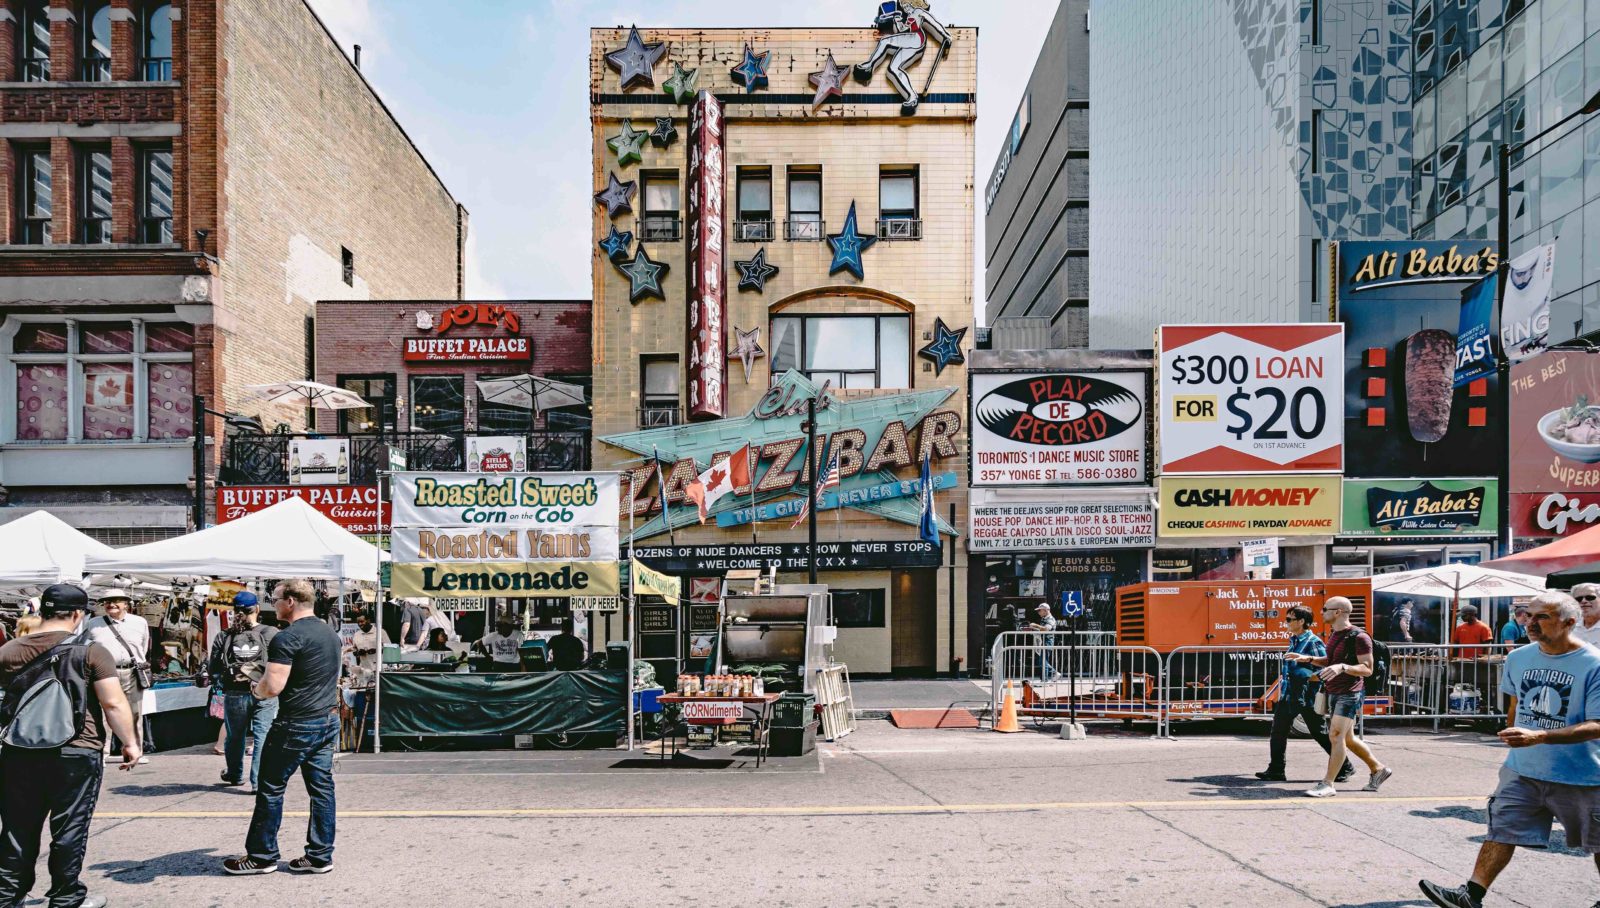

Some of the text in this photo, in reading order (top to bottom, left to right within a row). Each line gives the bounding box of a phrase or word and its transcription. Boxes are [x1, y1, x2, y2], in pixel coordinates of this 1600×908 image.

[1355, 245, 1499, 282] Ali Baba's
[437, 304, 520, 334] JOE'S
[408, 338, 527, 353] BUFFET PALACE
[1172, 355, 1323, 385] $300 LOAN
[1512, 358, 1568, 395] THE BEST
[1030, 375, 1092, 403] PLAY
[754, 379, 830, 419] Club
[1050, 402, 1070, 419] DE
[1176, 386, 1326, 440] FOR $20
[1009, 410, 1107, 445] RECORD
[978, 450, 1028, 464] TORONTO'S
[1038, 451, 1070, 463] DANCE
[1074, 450, 1105, 462] MUSIC
[1109, 450, 1140, 461] STORE
[1008, 470, 1041, 480] YONGE
[1078, 467, 1137, 479] 586-0380
[309, 488, 376, 504] PALAC
[414, 477, 598, 507] Roasted Sweet
[733, 506, 767, 522] THE
[839, 485, 892, 504] NEVER
[1377, 492, 1480, 519] Ali Baba's
[461, 508, 507, 523] Corn
[521, 511, 533, 520] the
[535, 508, 574, 523] Cob
[1094, 516, 1100, 524] R
[1102, 515, 1108, 524] &
[1120, 514, 1152, 523] TECHNO
[1010, 528, 1047, 537] CALYPSO
[1105, 525, 1152, 535] SOUL-JAZZ
[418, 530, 591, 559] Roasted Yams
[679, 548, 692, 557] OF
[696, 548, 727, 556] NUDE
[730, 546, 782, 556] DANCERS
[852, 544, 888, 553] NEVER
[894, 543, 932, 552] STOPS
[706, 560, 761, 569] WELCOME
[766, 559, 782, 568] TO
[787, 558, 808, 567] THE
[826, 558, 833, 566] X
[838, 557, 846, 566] X
[422, 566, 588, 591] Lemonade
[1216, 586, 1316, 599] Jack A. Frost Ltd.
[436, 598, 479, 610] ORDER HERE
[572, 598, 615, 609] PICK UP HERE
[1229, 600, 1302, 609] Mobile Power
[1523, 669, 1575, 685] ANTIGUA
[684, 702, 742, 717] CORNdiments
